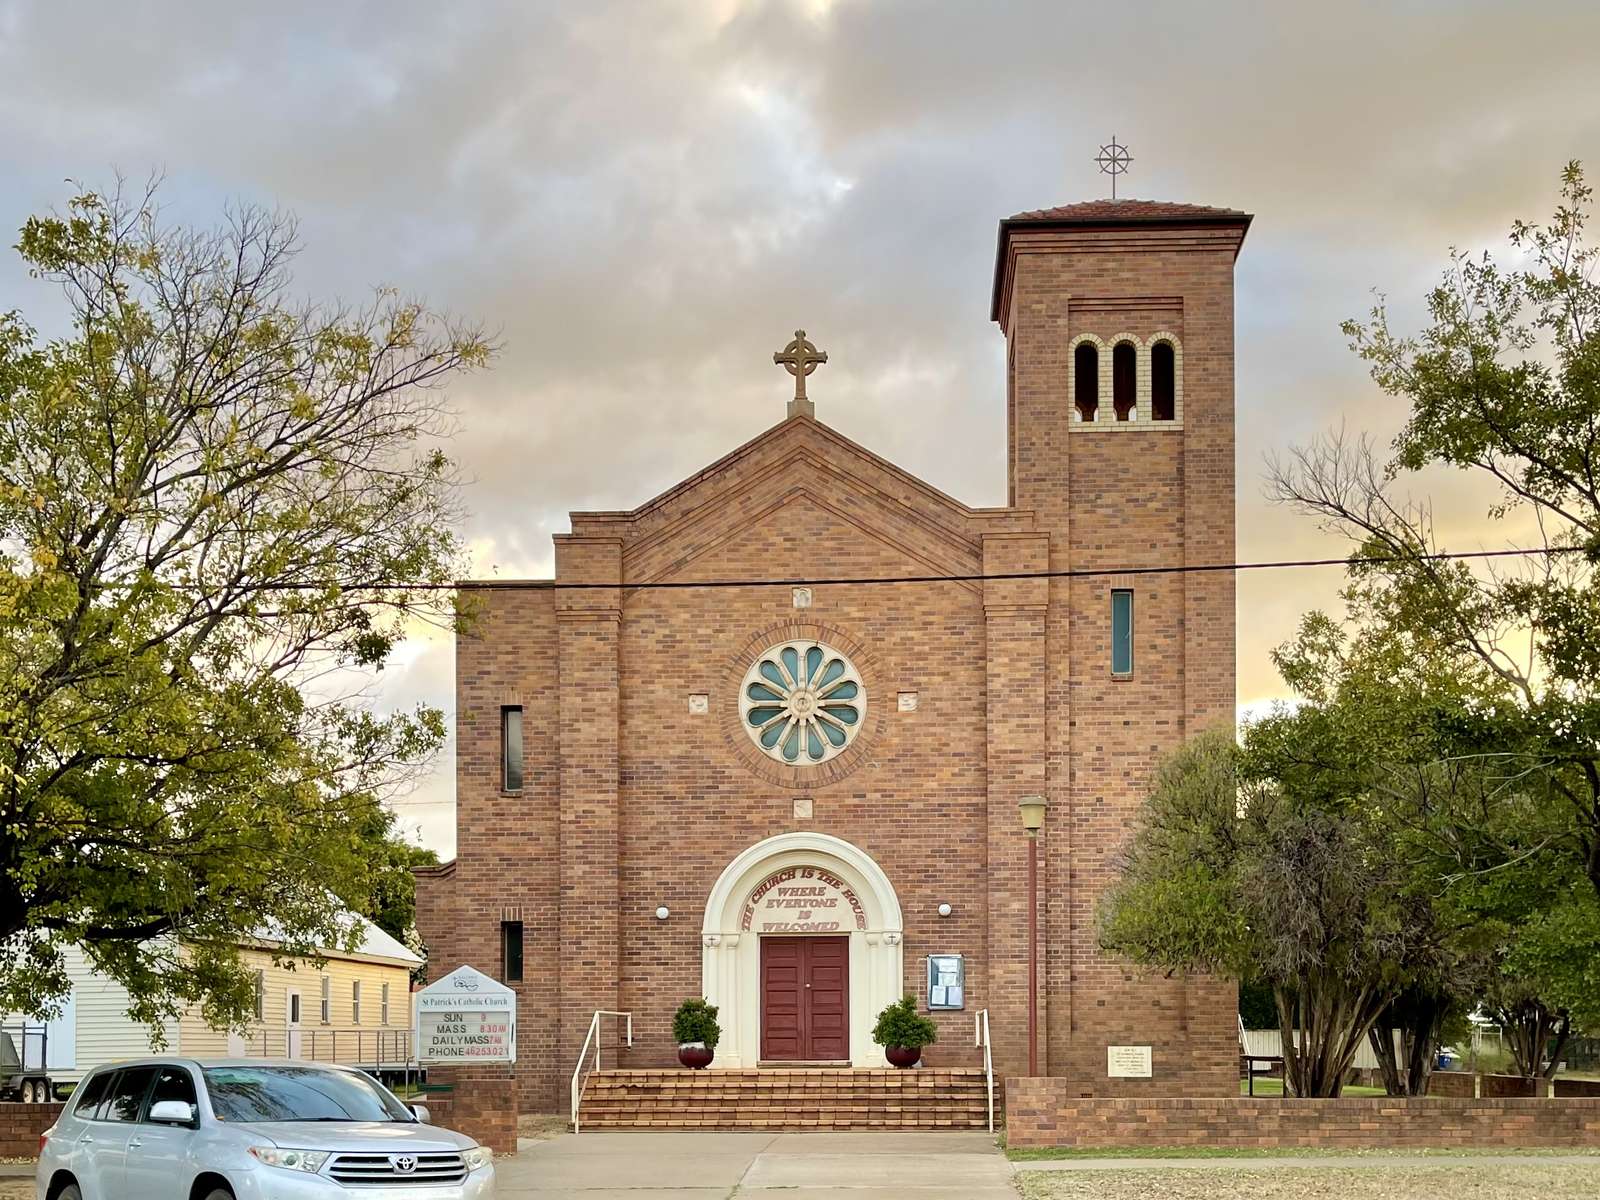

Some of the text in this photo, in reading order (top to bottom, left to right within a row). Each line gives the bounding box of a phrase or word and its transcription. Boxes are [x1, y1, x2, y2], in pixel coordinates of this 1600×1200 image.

[778, 887, 826, 897] WHERE
[742, 867, 867, 931] THE CHURCH IS THE HOUSE
[766, 898, 838, 908] EVERYONE
[798, 911, 812, 920] IS
[762, 922, 839, 932] WELCOMED
[430, 998, 457, 1006] Patrick's
[458, 998, 483, 1006] Catholic
[484, 998, 508, 1006] Church
[443, 1013, 463, 1022] SUN
[437, 1024, 466, 1033] MASS
[432, 1036, 463, 1045] DAILY
[464, 1035, 489, 1045] MASS
[428, 1048, 464, 1056] PHONE
